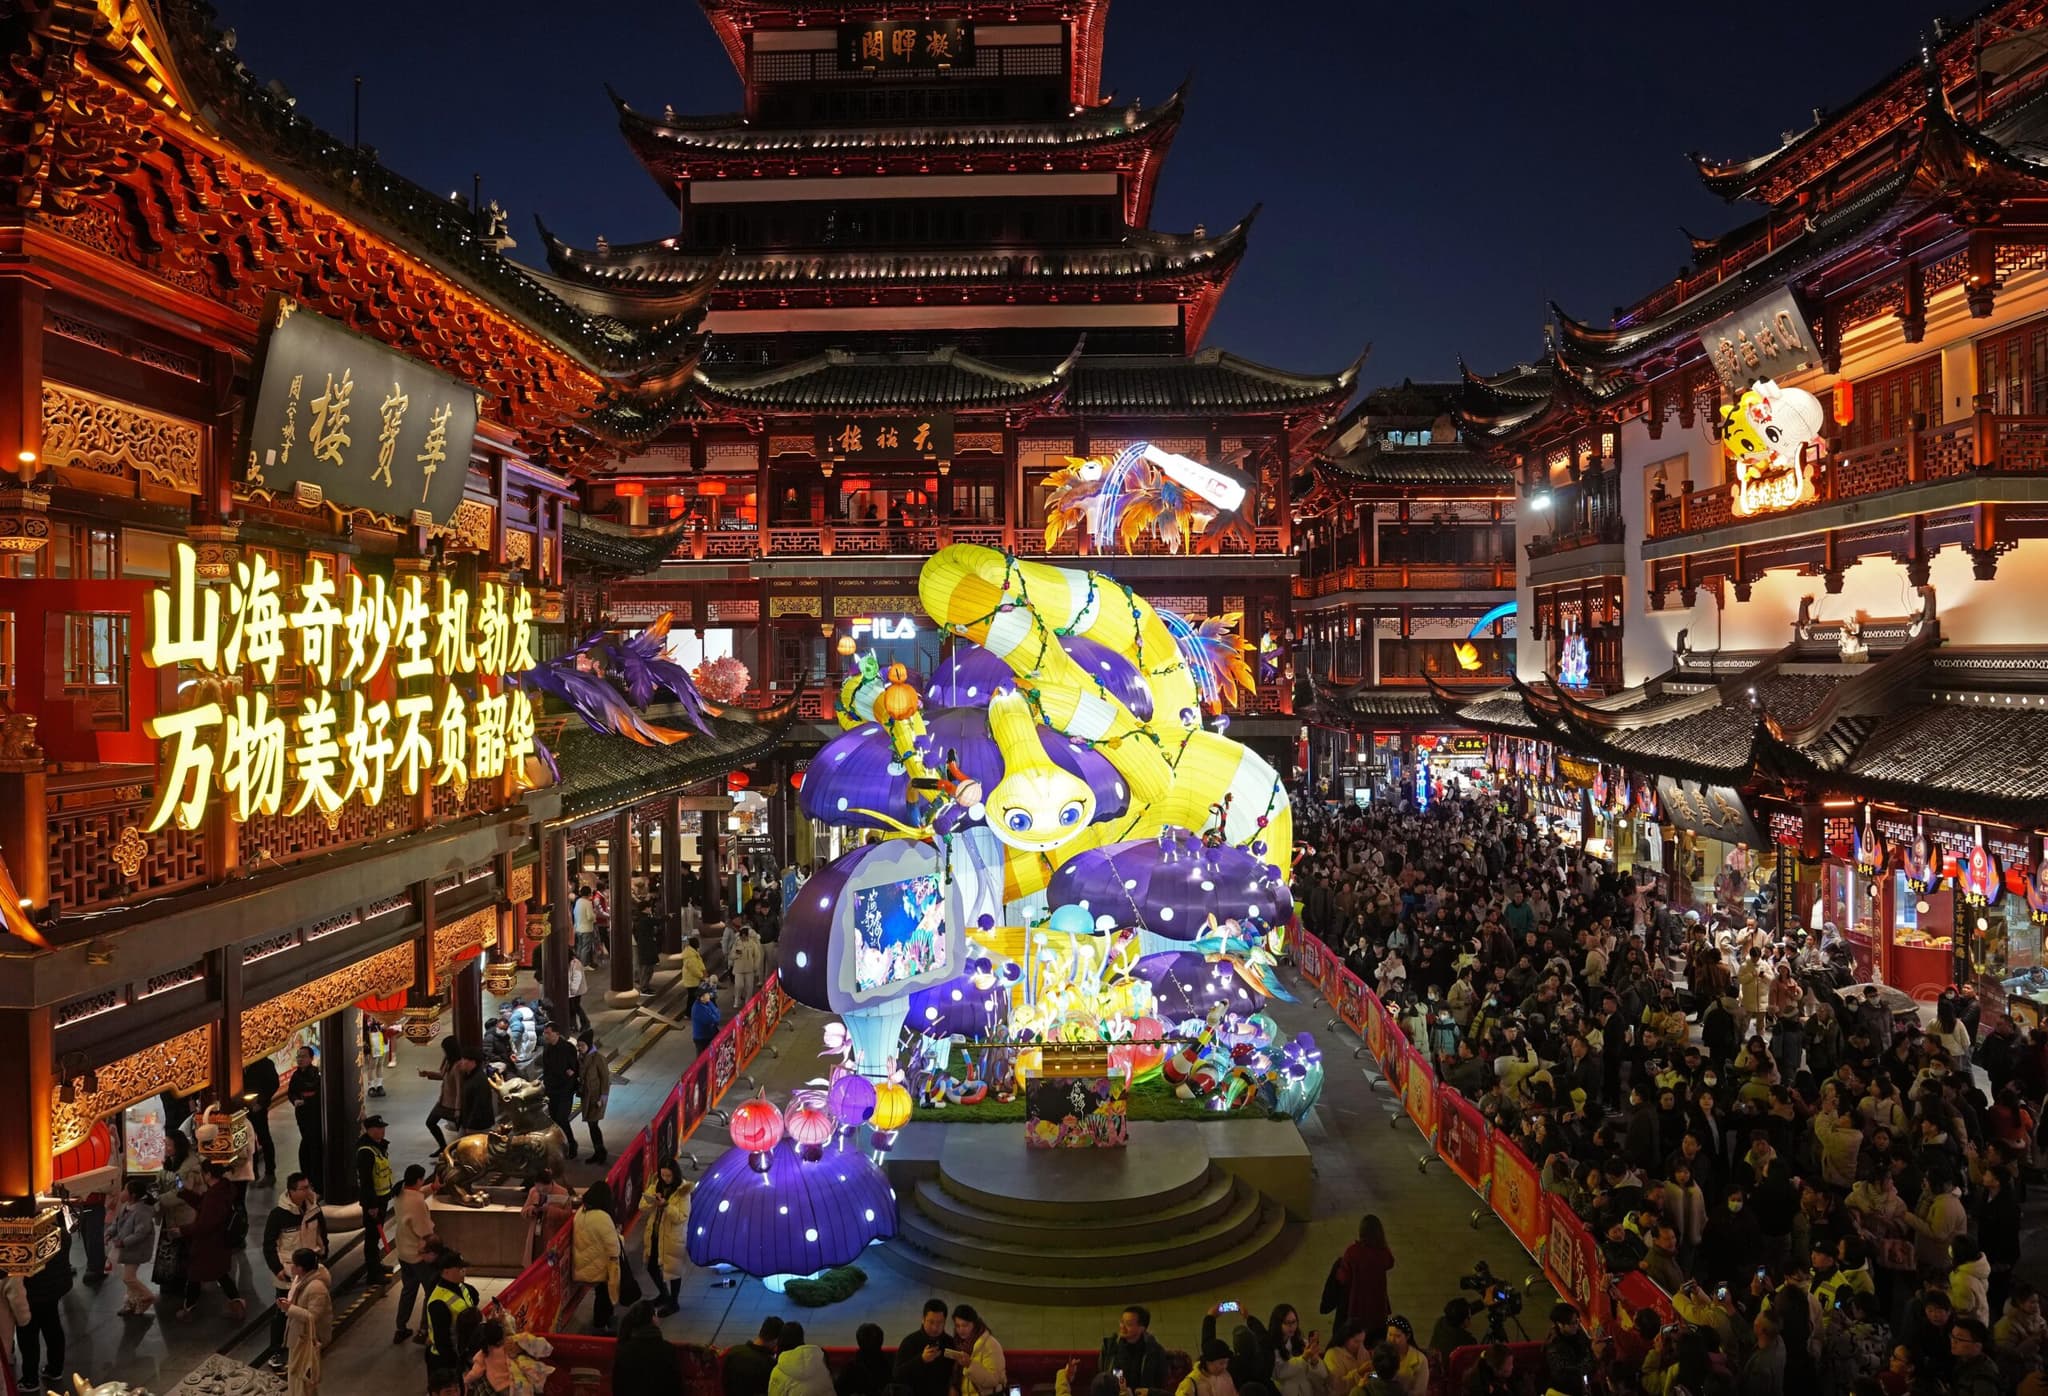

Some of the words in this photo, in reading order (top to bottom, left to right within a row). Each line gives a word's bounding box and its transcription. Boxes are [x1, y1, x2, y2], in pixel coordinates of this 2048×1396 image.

[144, 542, 538, 685] 山海奇妙生机勃发
[851, 617, 917, 640] FILA
[141, 684, 537, 833] 万物美好不负韶华
